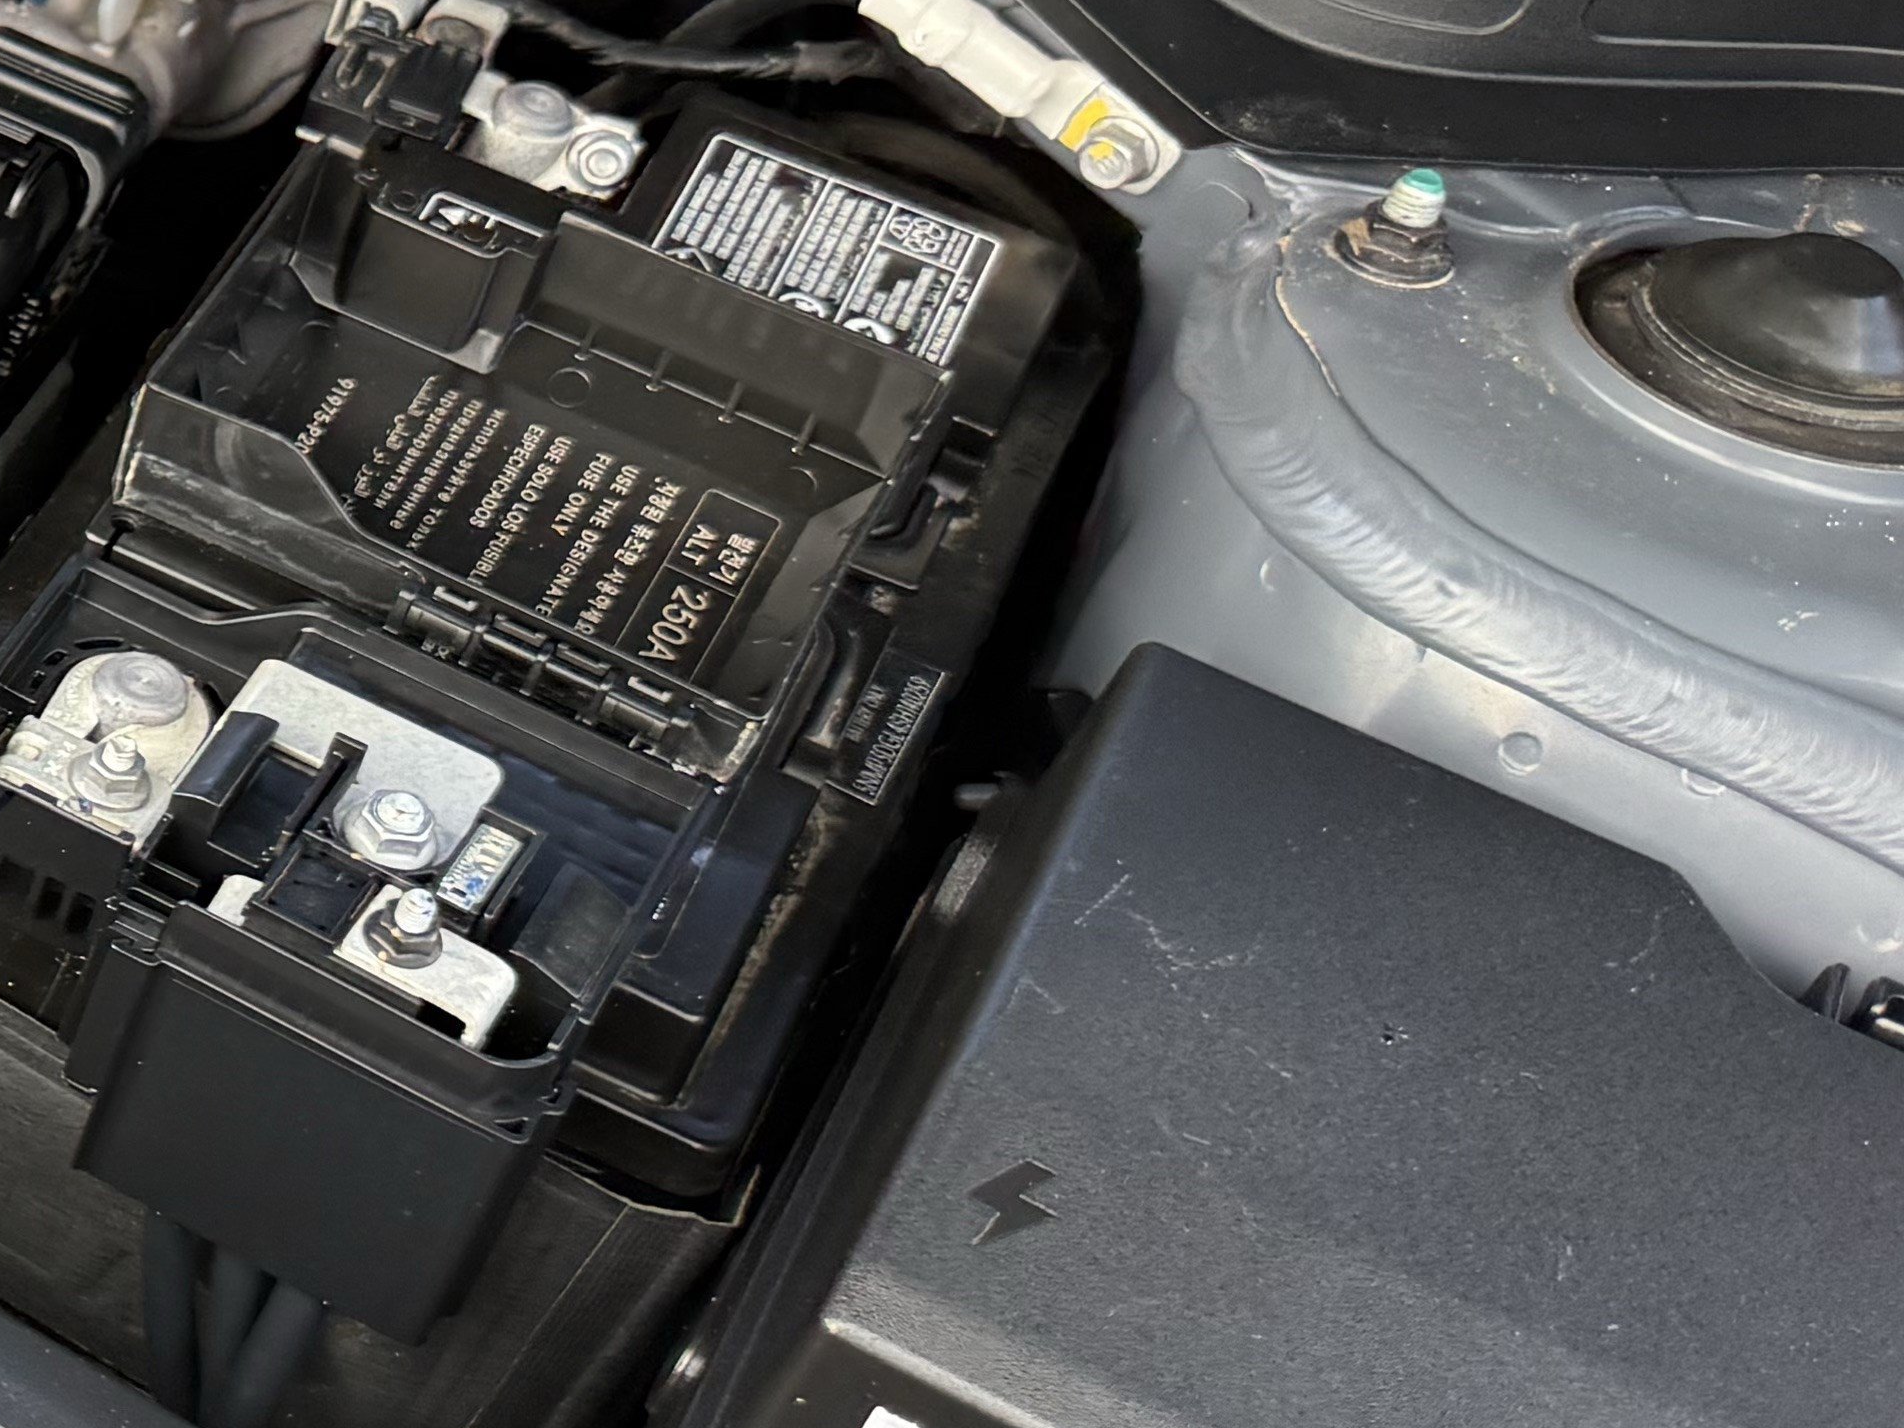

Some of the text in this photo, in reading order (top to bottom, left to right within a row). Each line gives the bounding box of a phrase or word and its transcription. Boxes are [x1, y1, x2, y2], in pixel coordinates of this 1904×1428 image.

[542, 434, 572, 465] USE
[467, 422, 545, 530] ESPECIFICADOS
[517, 461, 555, 505] SOLO
[548, 451, 613, 537] FUSE ONLY
[608, 462, 640, 496] USE
[499, 501, 530, 534] LOS
[587, 495, 619, 529] THE
[678, 523, 719, 566] ALT
[706, 531, 757, 587] 발전기
[637, 583, 710, 670] 250A
